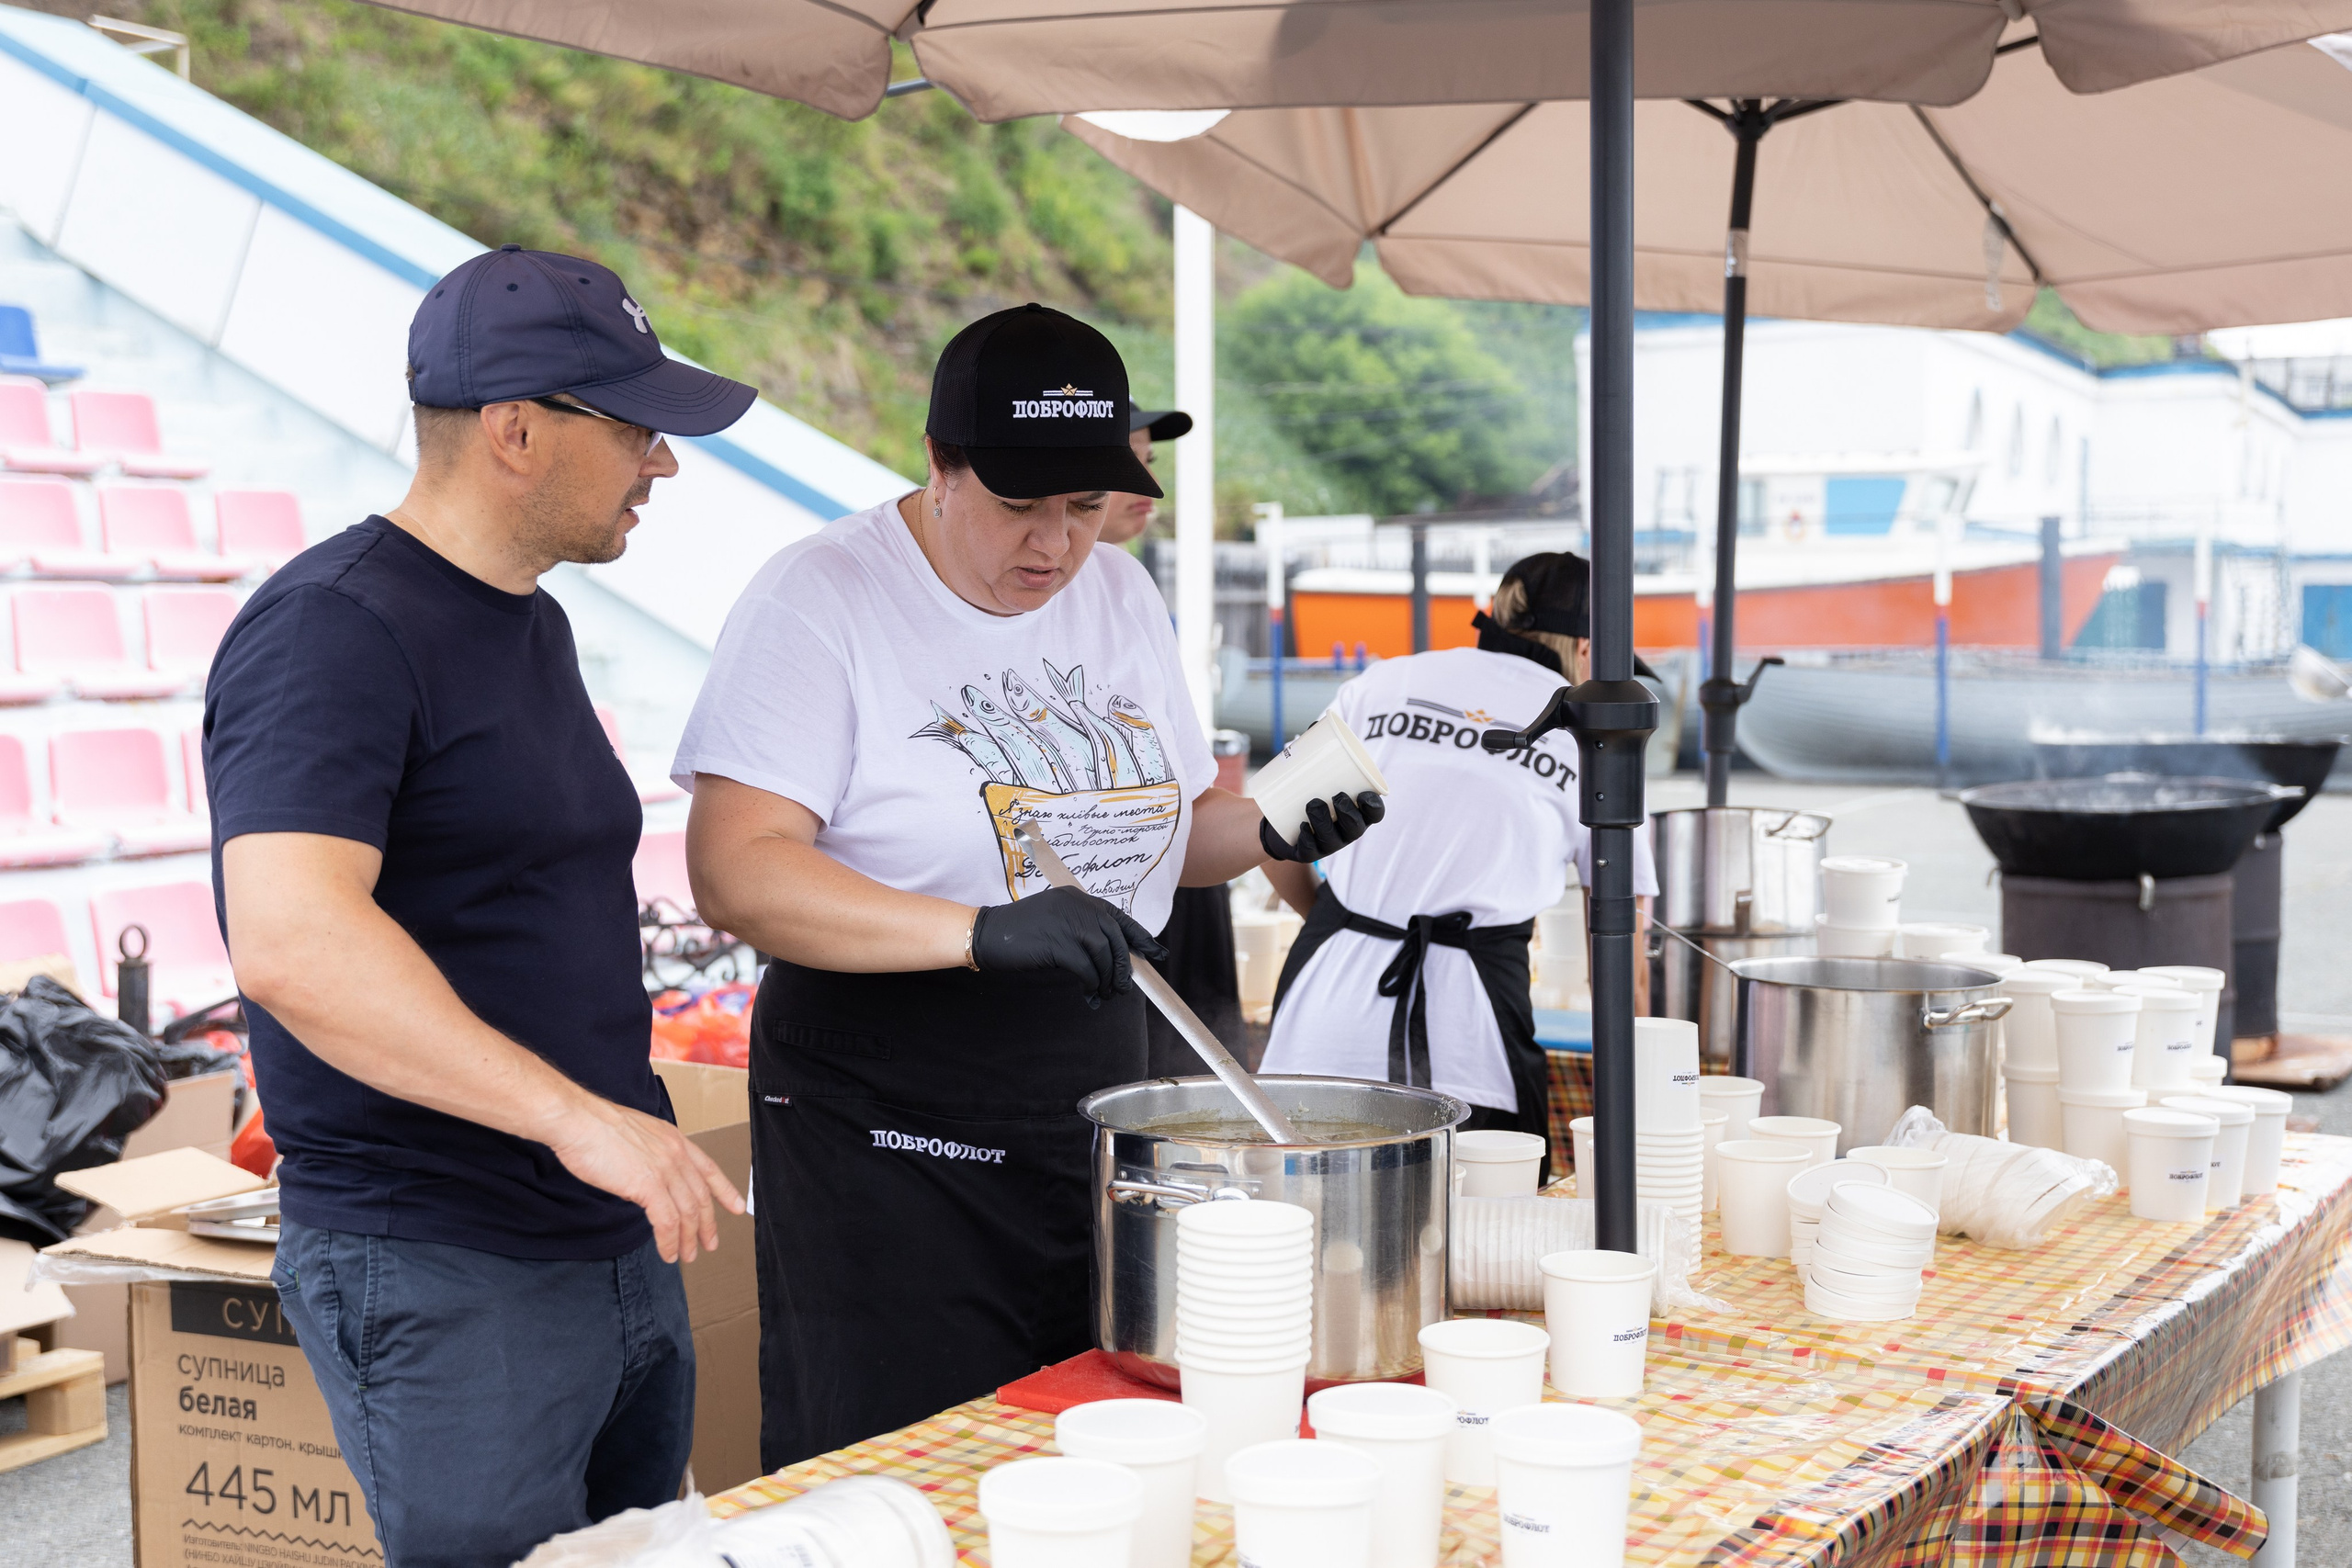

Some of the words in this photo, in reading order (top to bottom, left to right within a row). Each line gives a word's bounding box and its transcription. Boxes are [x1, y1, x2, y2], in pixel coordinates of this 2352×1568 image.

[1012, 400, 1114, 419] ДОБРОФЛОТ
[1364, 712, 1577, 792] ДОБРОЛОТ
[869, 1130, 1006, 1164] ДОБРОФЛОТ
[177, 1353, 286, 1391] супница
[179, 1385, 257, 1421] белая
[178, 1423, 243, 1442] комплект
[246, 1431, 296, 1451] картон.
[186, 1461, 277, 1515] 445
